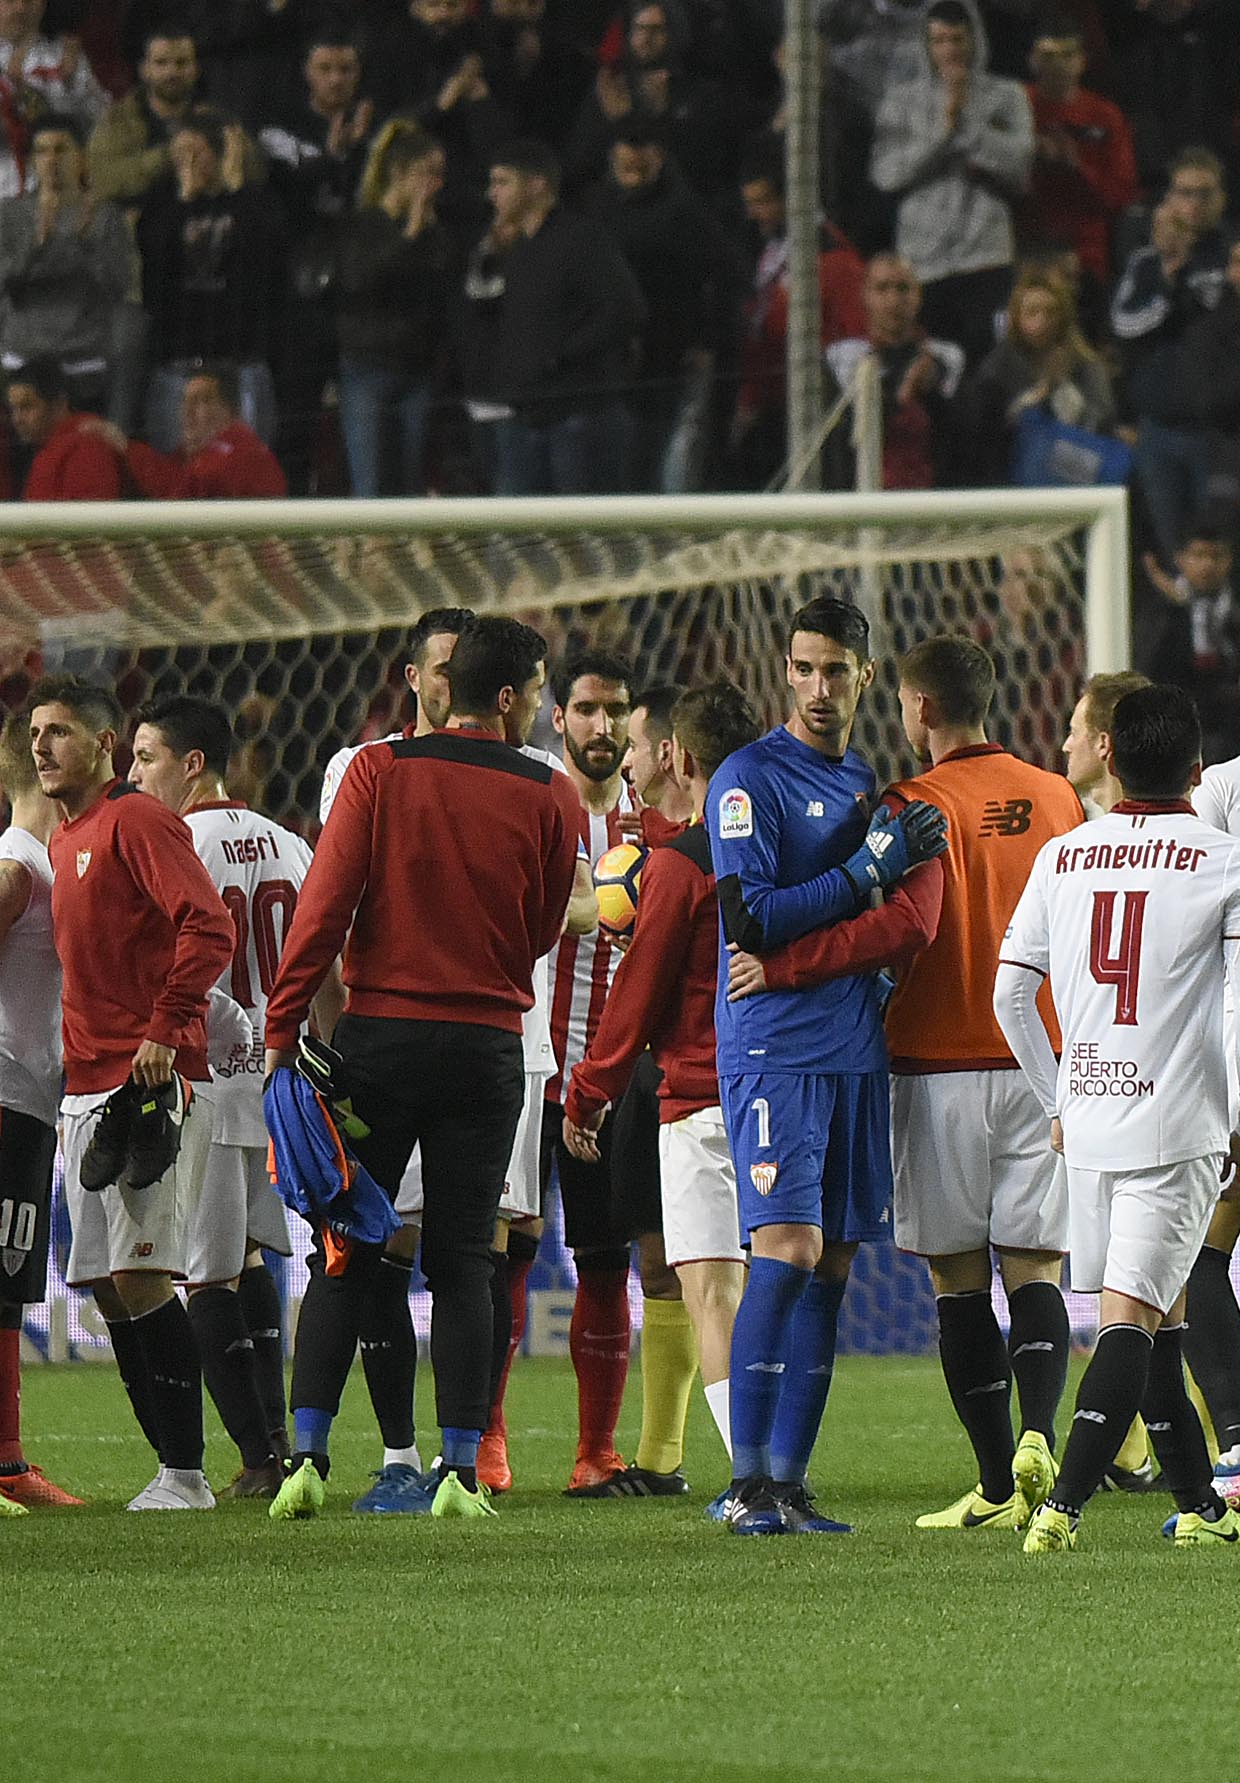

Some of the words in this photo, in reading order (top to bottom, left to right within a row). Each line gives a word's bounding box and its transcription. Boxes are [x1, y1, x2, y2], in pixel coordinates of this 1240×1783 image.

[722, 822, 750, 833] LaLiga
[220, 830, 280, 865] nasri
[1055, 839, 1208, 875] kranevitter
[221, 878, 299, 1009] 10
[1089, 890, 1150, 1026] 4
[1070, 1043, 1099, 1060] SEE
[1070, 1062, 1138, 1078] PUERTO
[1069, 1080, 1155, 1097] RICO.COM
[752, 1097, 771, 1148] 1
[0, 1198, 37, 1251] 10
